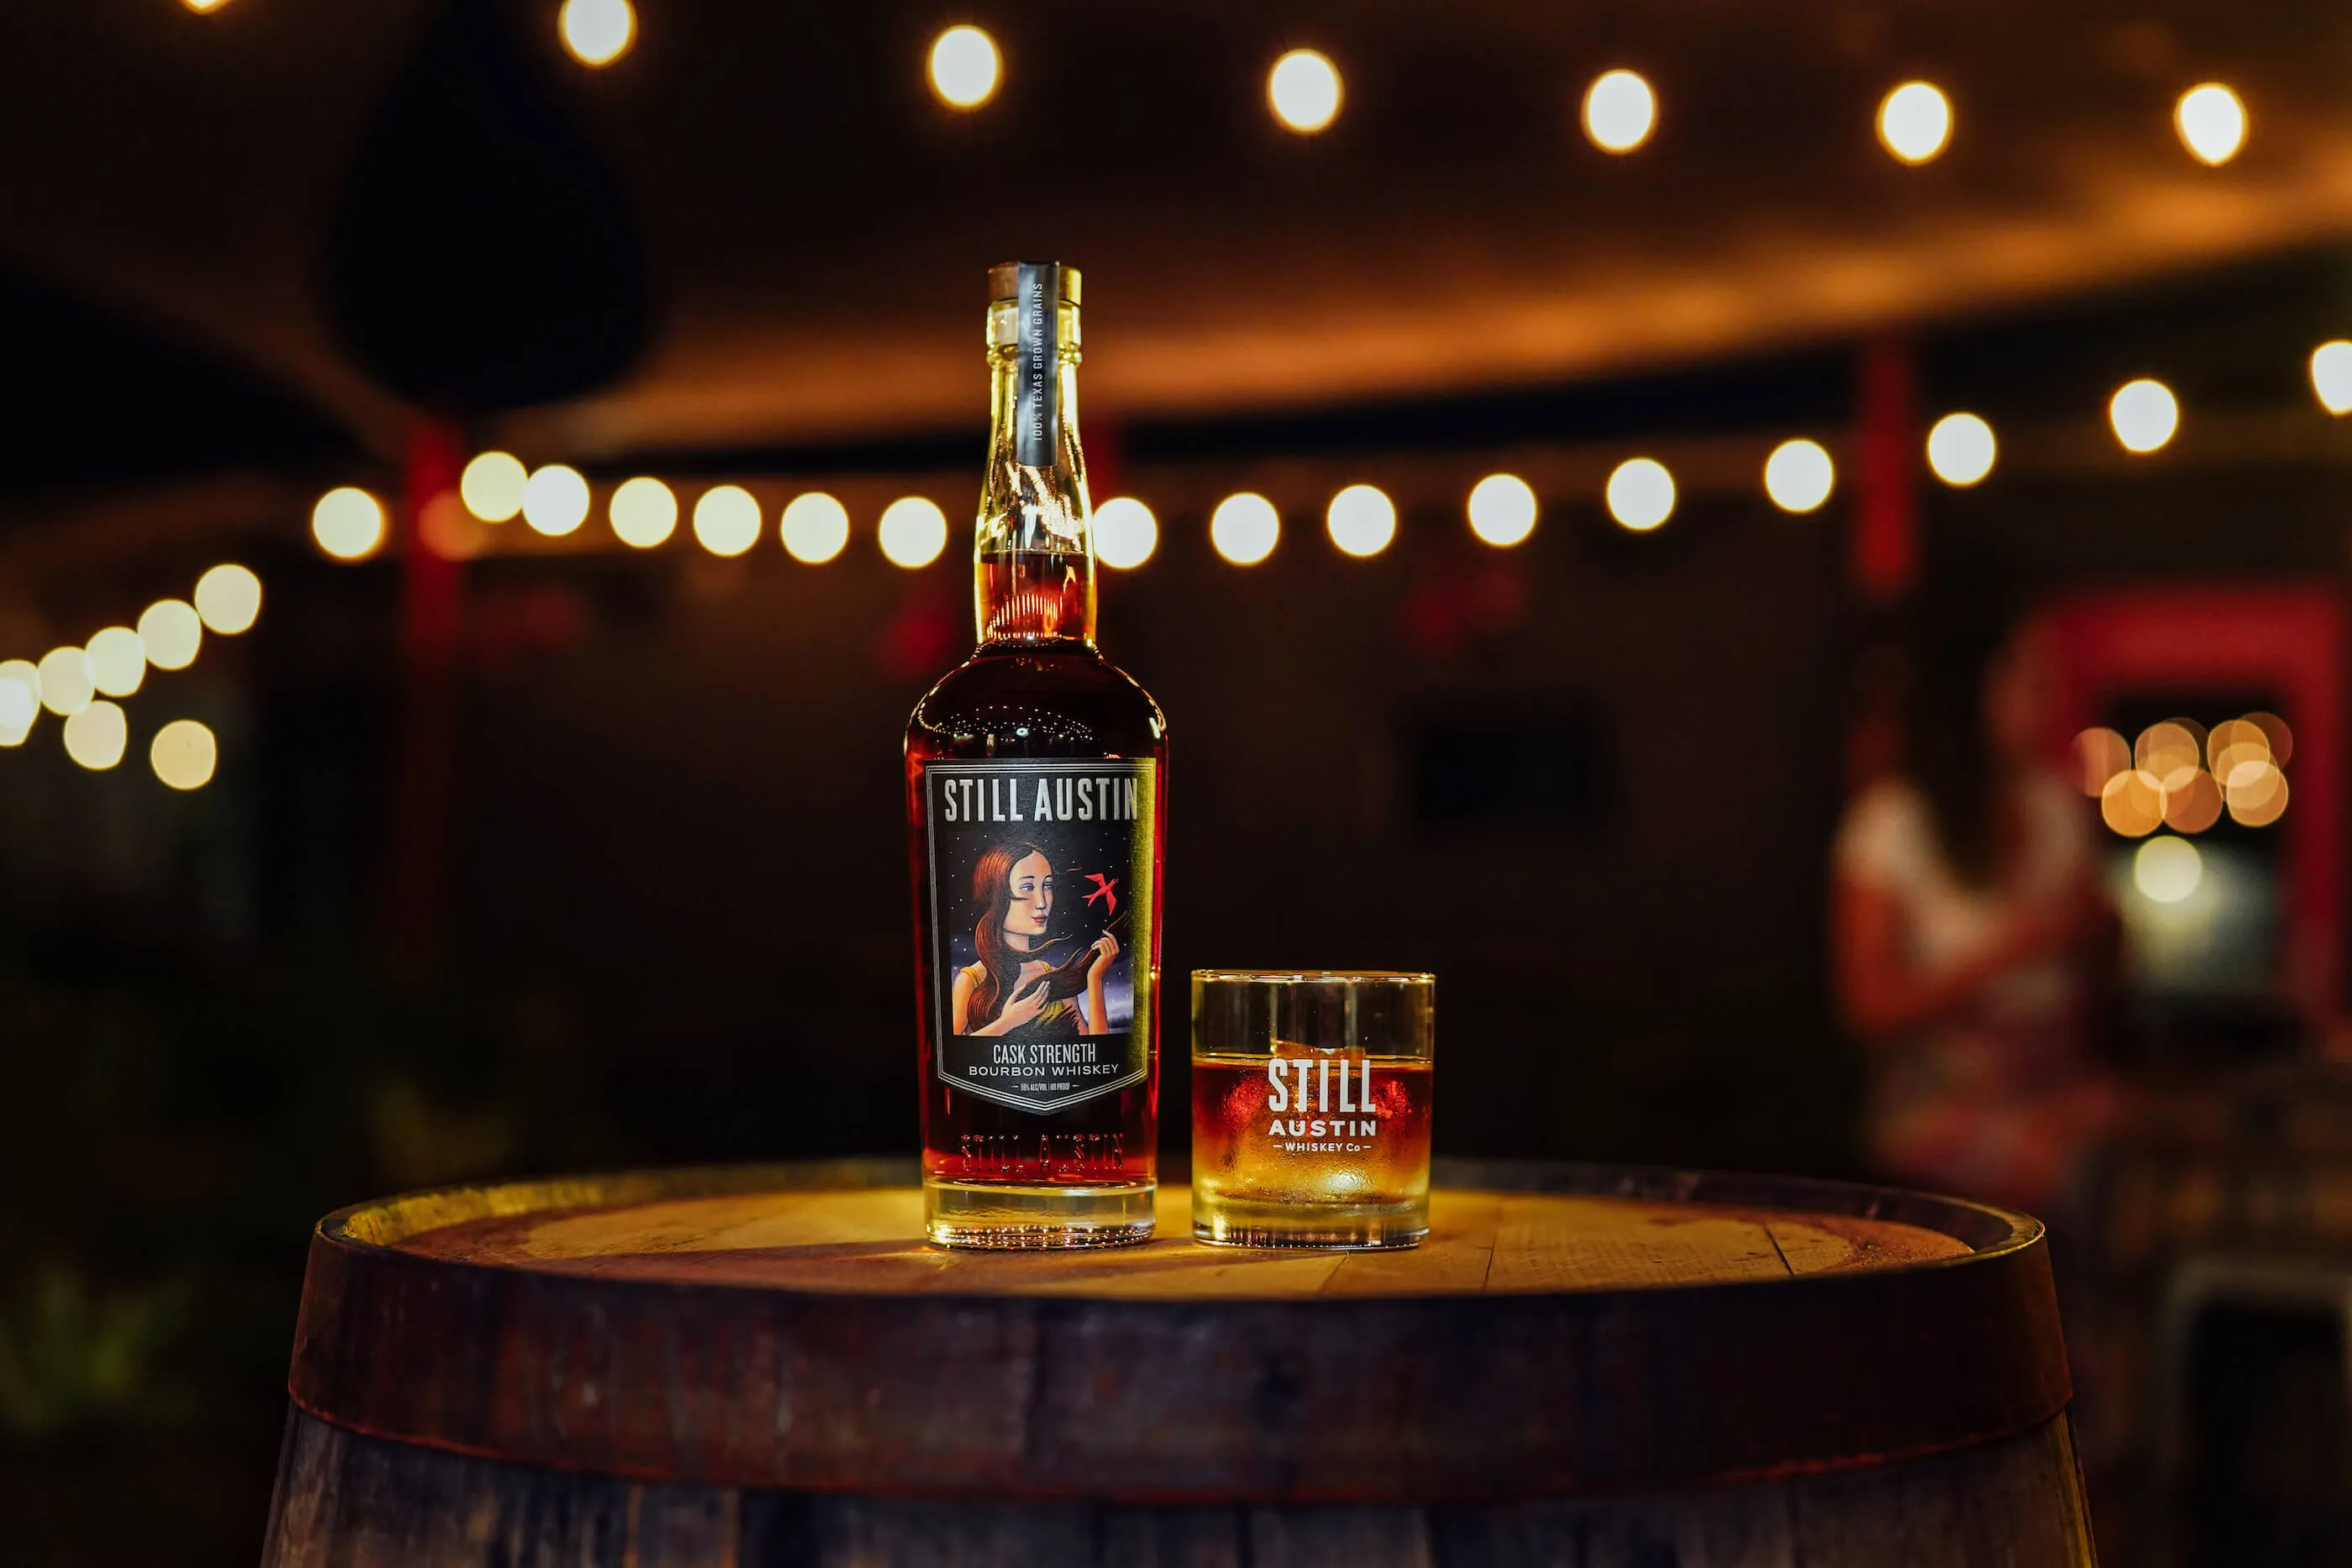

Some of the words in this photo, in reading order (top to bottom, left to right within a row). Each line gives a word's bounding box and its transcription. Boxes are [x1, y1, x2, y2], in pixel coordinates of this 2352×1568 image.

[1032, 283, 1043, 325] GRAINS
[1032, 329, 1042, 370] GROWN
[1032, 373, 1042, 408] TEXAS
[1033, 412, 1042, 441] 100%
[944, 778, 1023, 822] STILL
[1034, 778, 1137, 821] AUSTIN
[993, 1044, 1025, 1064] CASK
[1030, 1043, 1095, 1064] STRENGTH
[969, 1066, 1045, 1077] BOURBON
[1052, 1064, 1119, 1076] WHISKEY
[1268, 1058, 1376, 1113] STILL
[1268, 1120, 1376, 1136] AUSTIN
[1285, 1141, 1341, 1152] WHISKEY
[1346, 1141, 1360, 1152] Co
